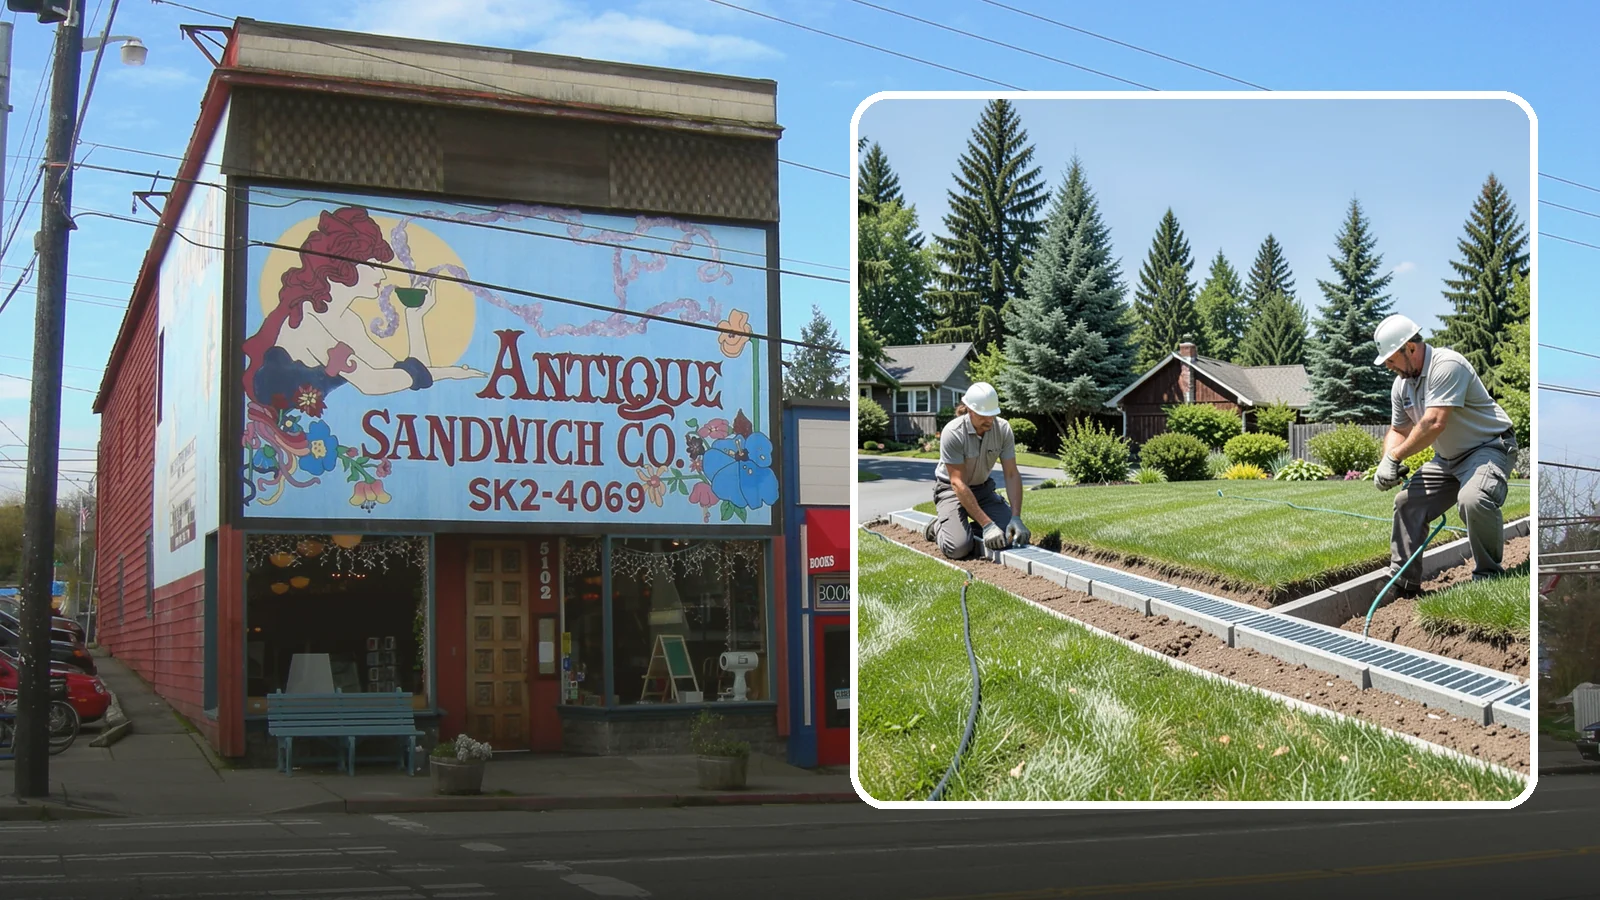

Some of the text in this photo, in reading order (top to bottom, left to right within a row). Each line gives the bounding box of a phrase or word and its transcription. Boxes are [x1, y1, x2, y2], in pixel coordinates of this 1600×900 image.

[475, 329, 724, 420] ANTIQUE
[361, 408, 686, 468] SANDWICH CO.
[468, 478, 645, 513] SK2-4069
[540, 541, 551, 599] 5102
[809, 555, 835, 569] BOOKS
